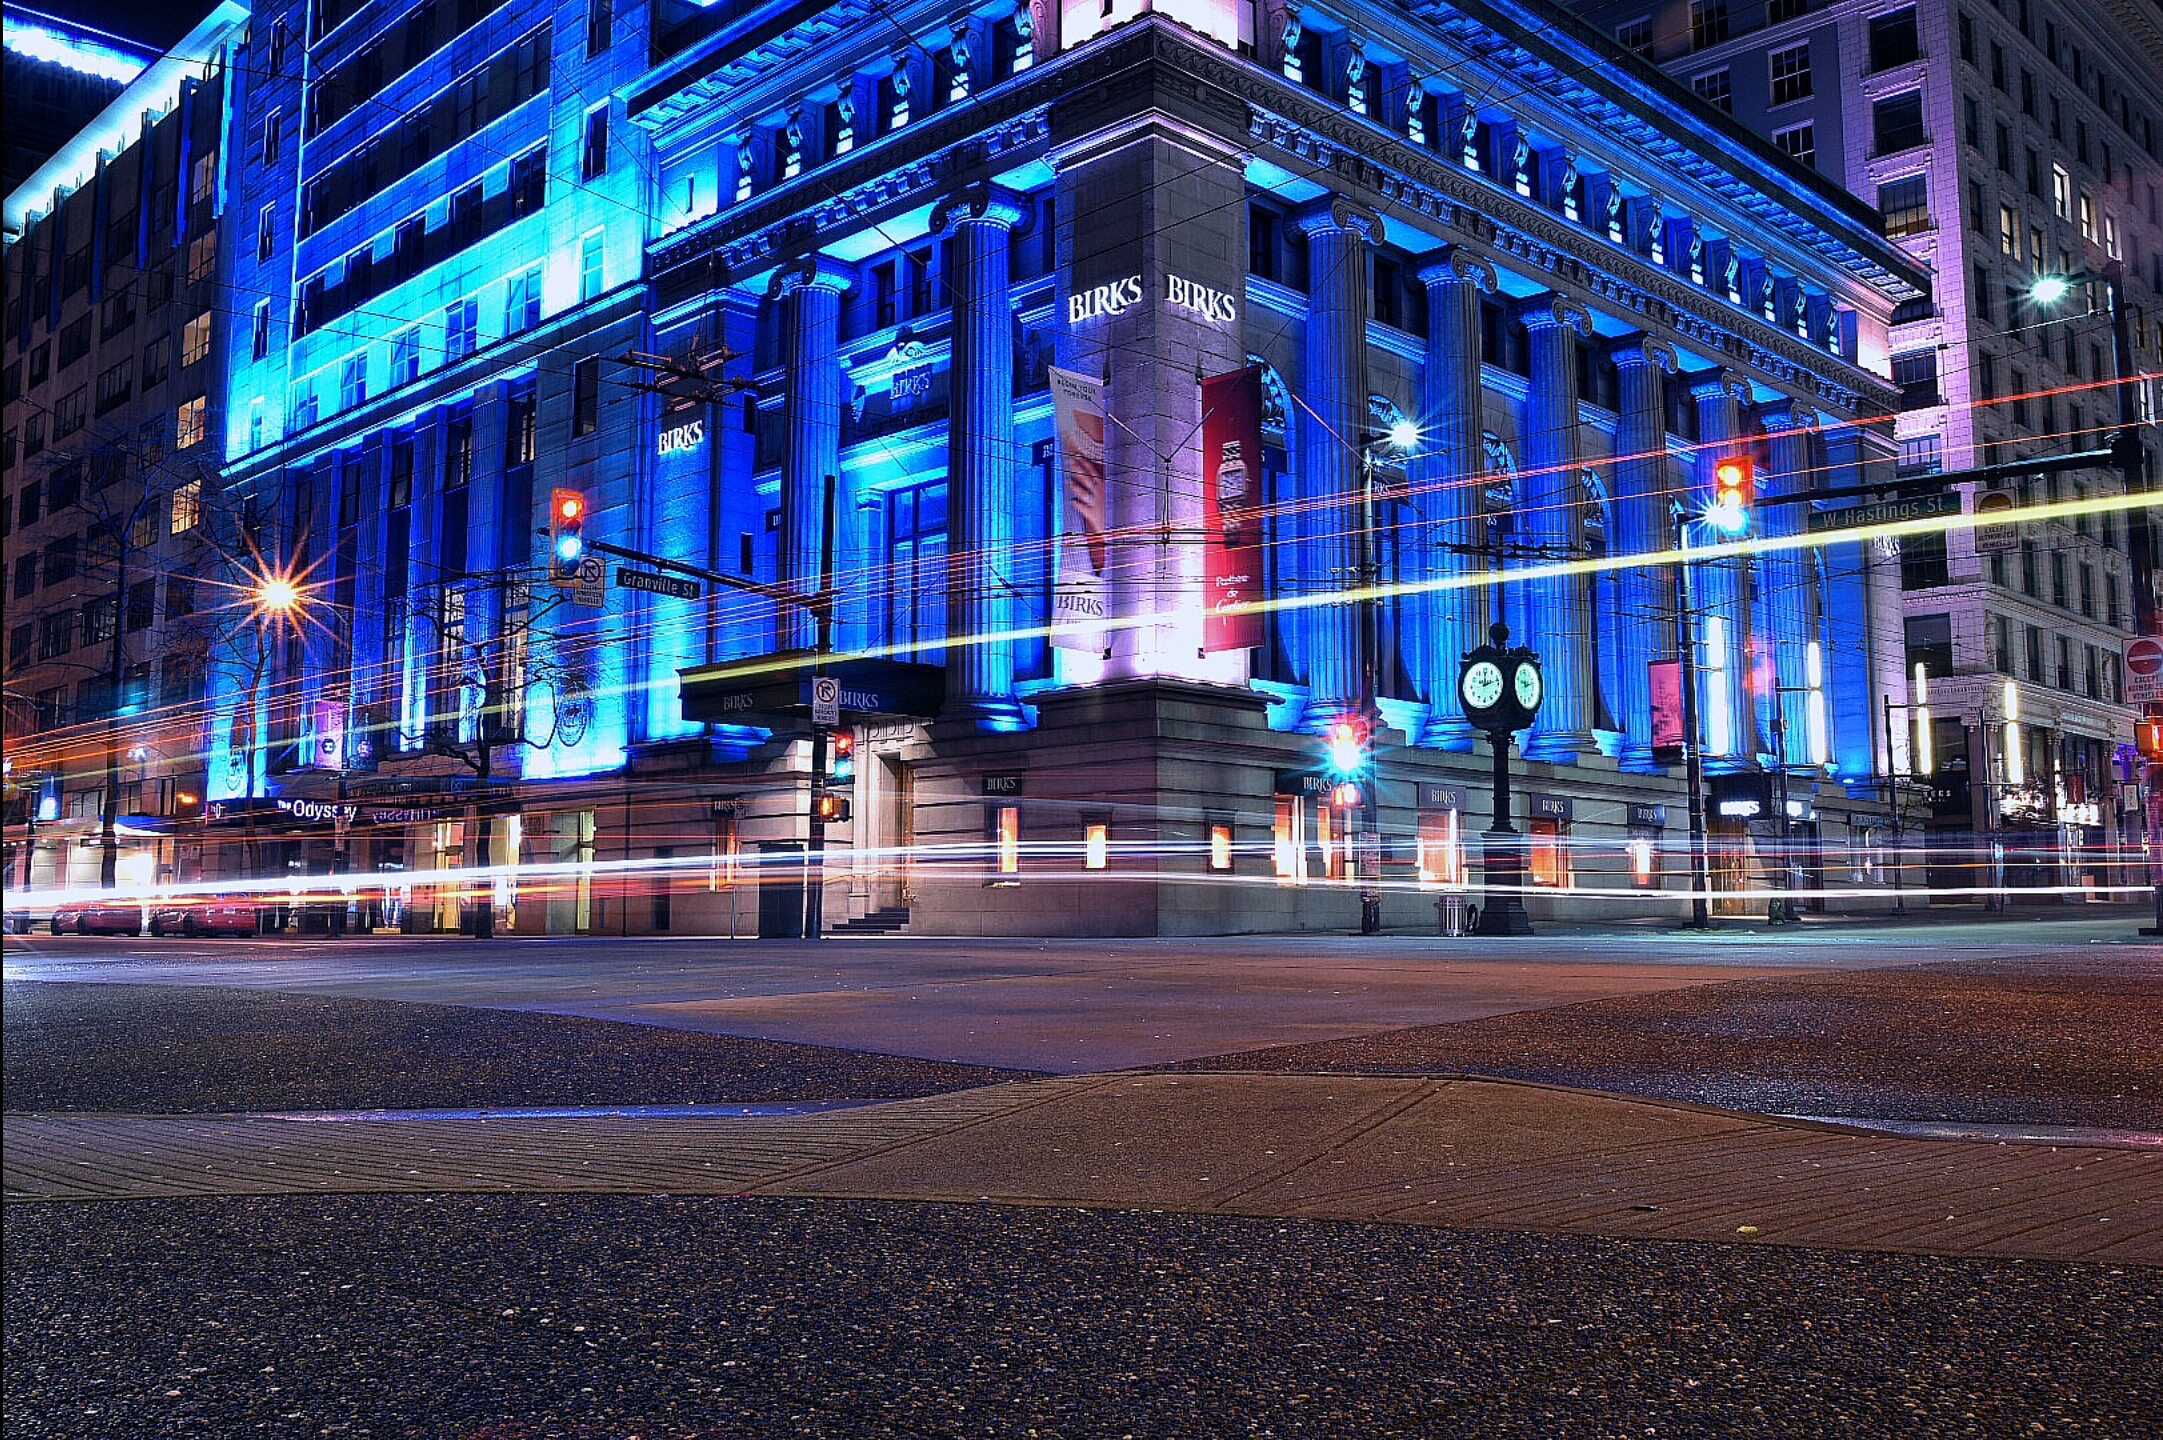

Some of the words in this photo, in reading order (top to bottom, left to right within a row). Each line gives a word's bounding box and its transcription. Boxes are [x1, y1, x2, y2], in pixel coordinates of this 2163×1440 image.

[1068, 274, 1143, 323] BIRKS
[1165, 274, 1236, 322] BIRKS
[889, 371, 930, 400] BIRKS
[657, 419, 703, 455] BIRKS
[1822, 512, 1837, 528] W
[1845, 500, 1919, 524] Hastings
[1927, 496, 1944, 513] St
[623, 572, 678, 594] Granville
[682, 583, 693, 597] St
[1056, 595, 1104, 617] BIRKS
[723, 693, 753, 712] BIRKS
[839, 690, 879, 709] BIRKS
[1303, 776, 1332, 794] BIRKS
